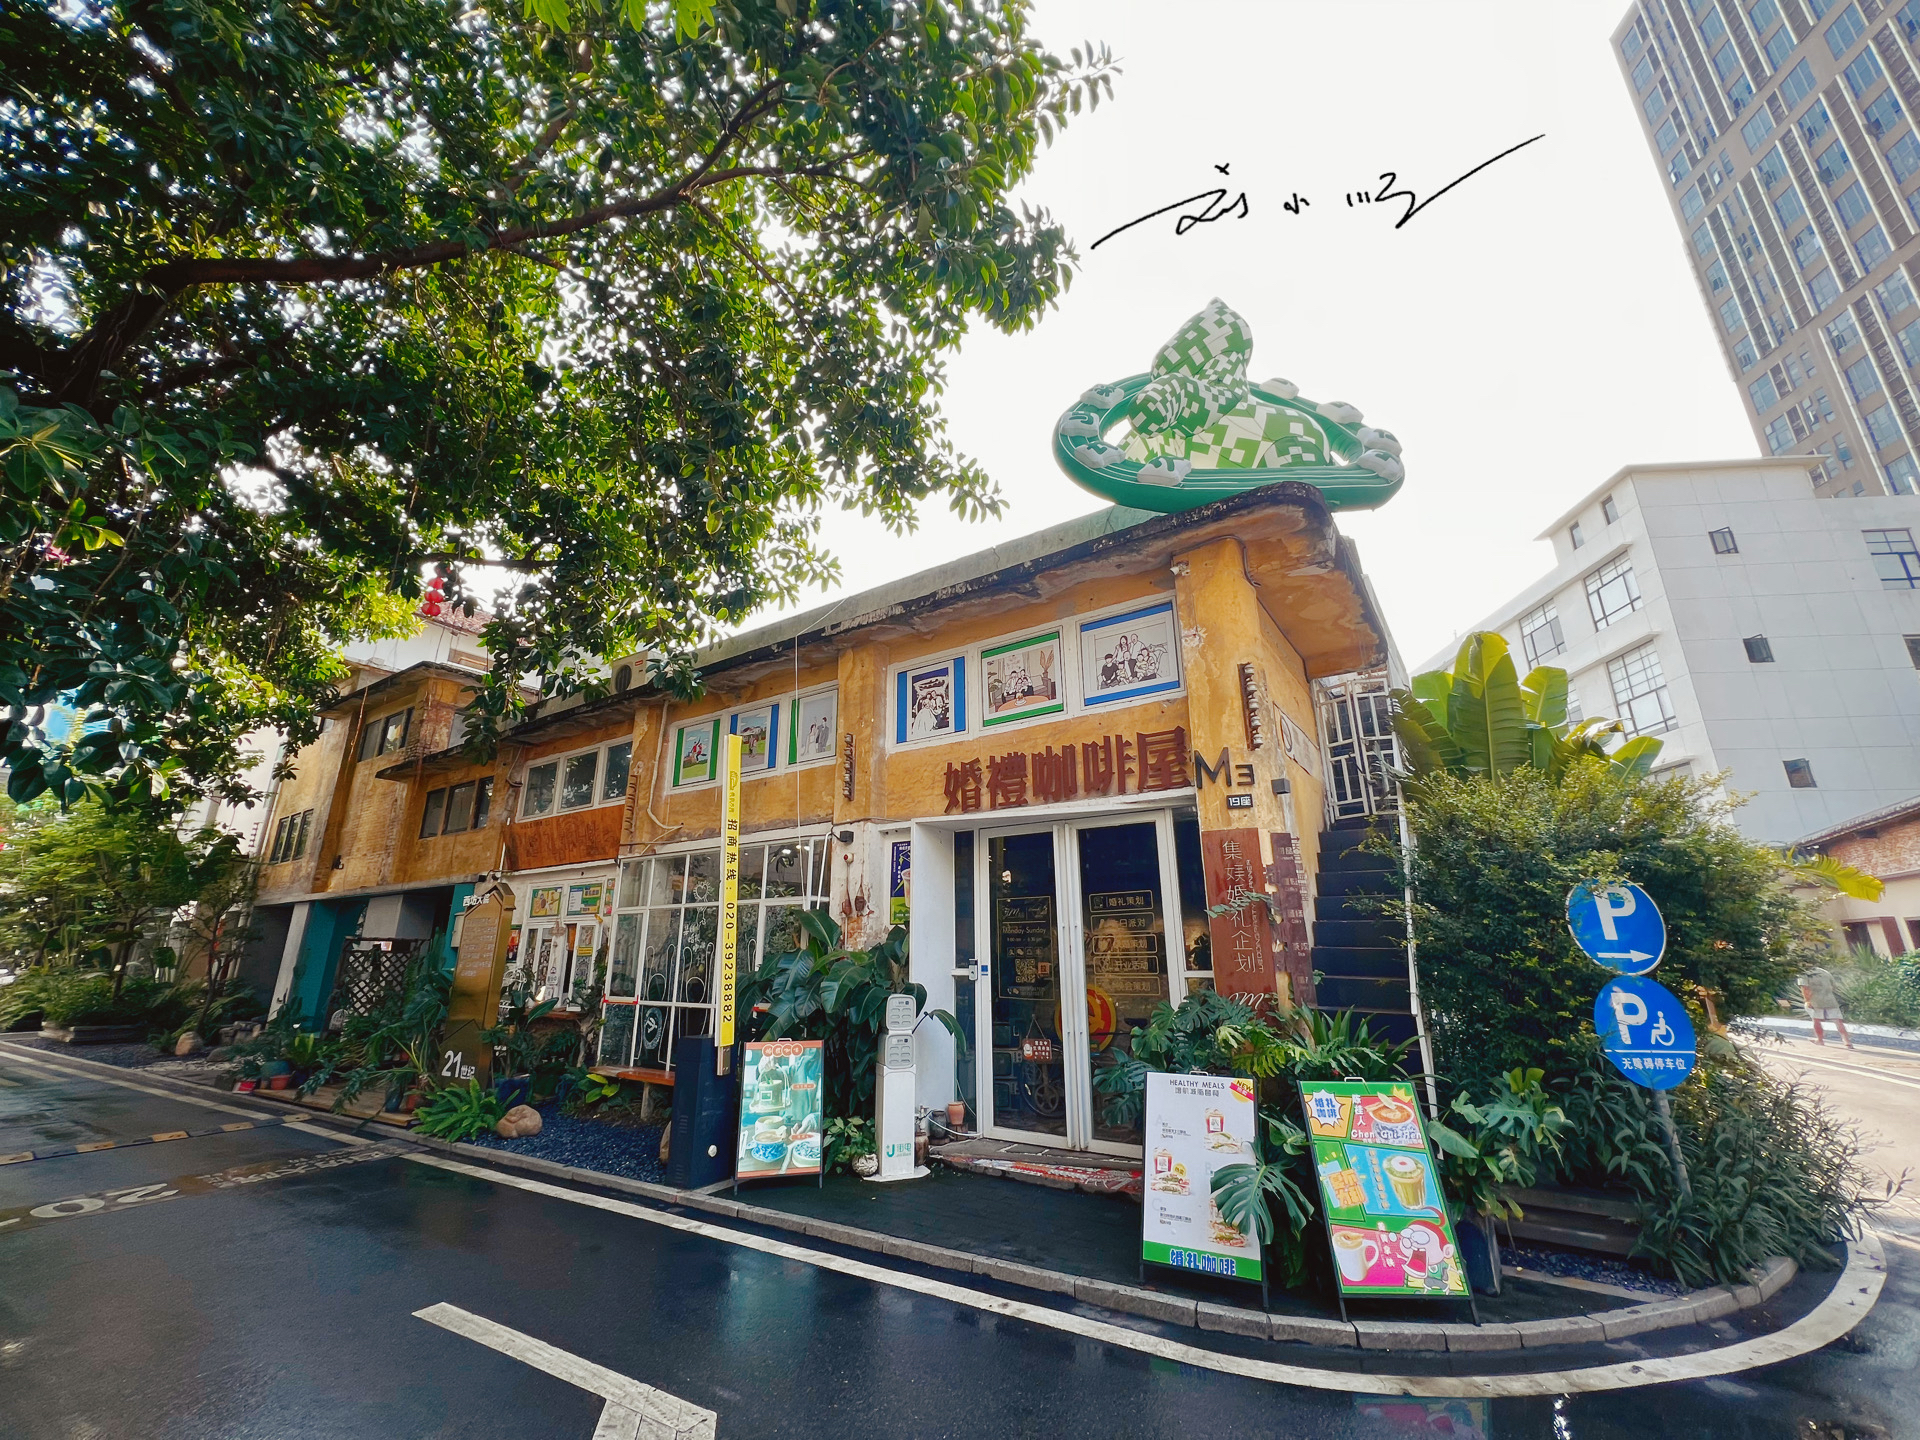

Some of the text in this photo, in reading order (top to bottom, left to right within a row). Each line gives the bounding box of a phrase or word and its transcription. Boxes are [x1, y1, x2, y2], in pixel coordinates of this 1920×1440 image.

[943, 725, 1192, 814] 婚禮咖啡屋
[1228, 796, 1251, 807] 19座
[1108, 896, 1145, 907] 婚礼策划
[1594, 884, 1637, 940] P
[1003, 924, 1046, 935] Monday Sunday
[1611, 992, 1648, 1044] P
[1621, 1057, 1687, 1070] 无障碍停车位
[1169, 1079, 1225, 1090] HEALTHY MEALS
[1236, 1080, 1254, 1092] NEW
[1314, 1097, 1336, 1108] 婚礼
[1316, 1108, 1338, 1118] 咖啡
[1351, 1129, 1375, 1138] Chen
